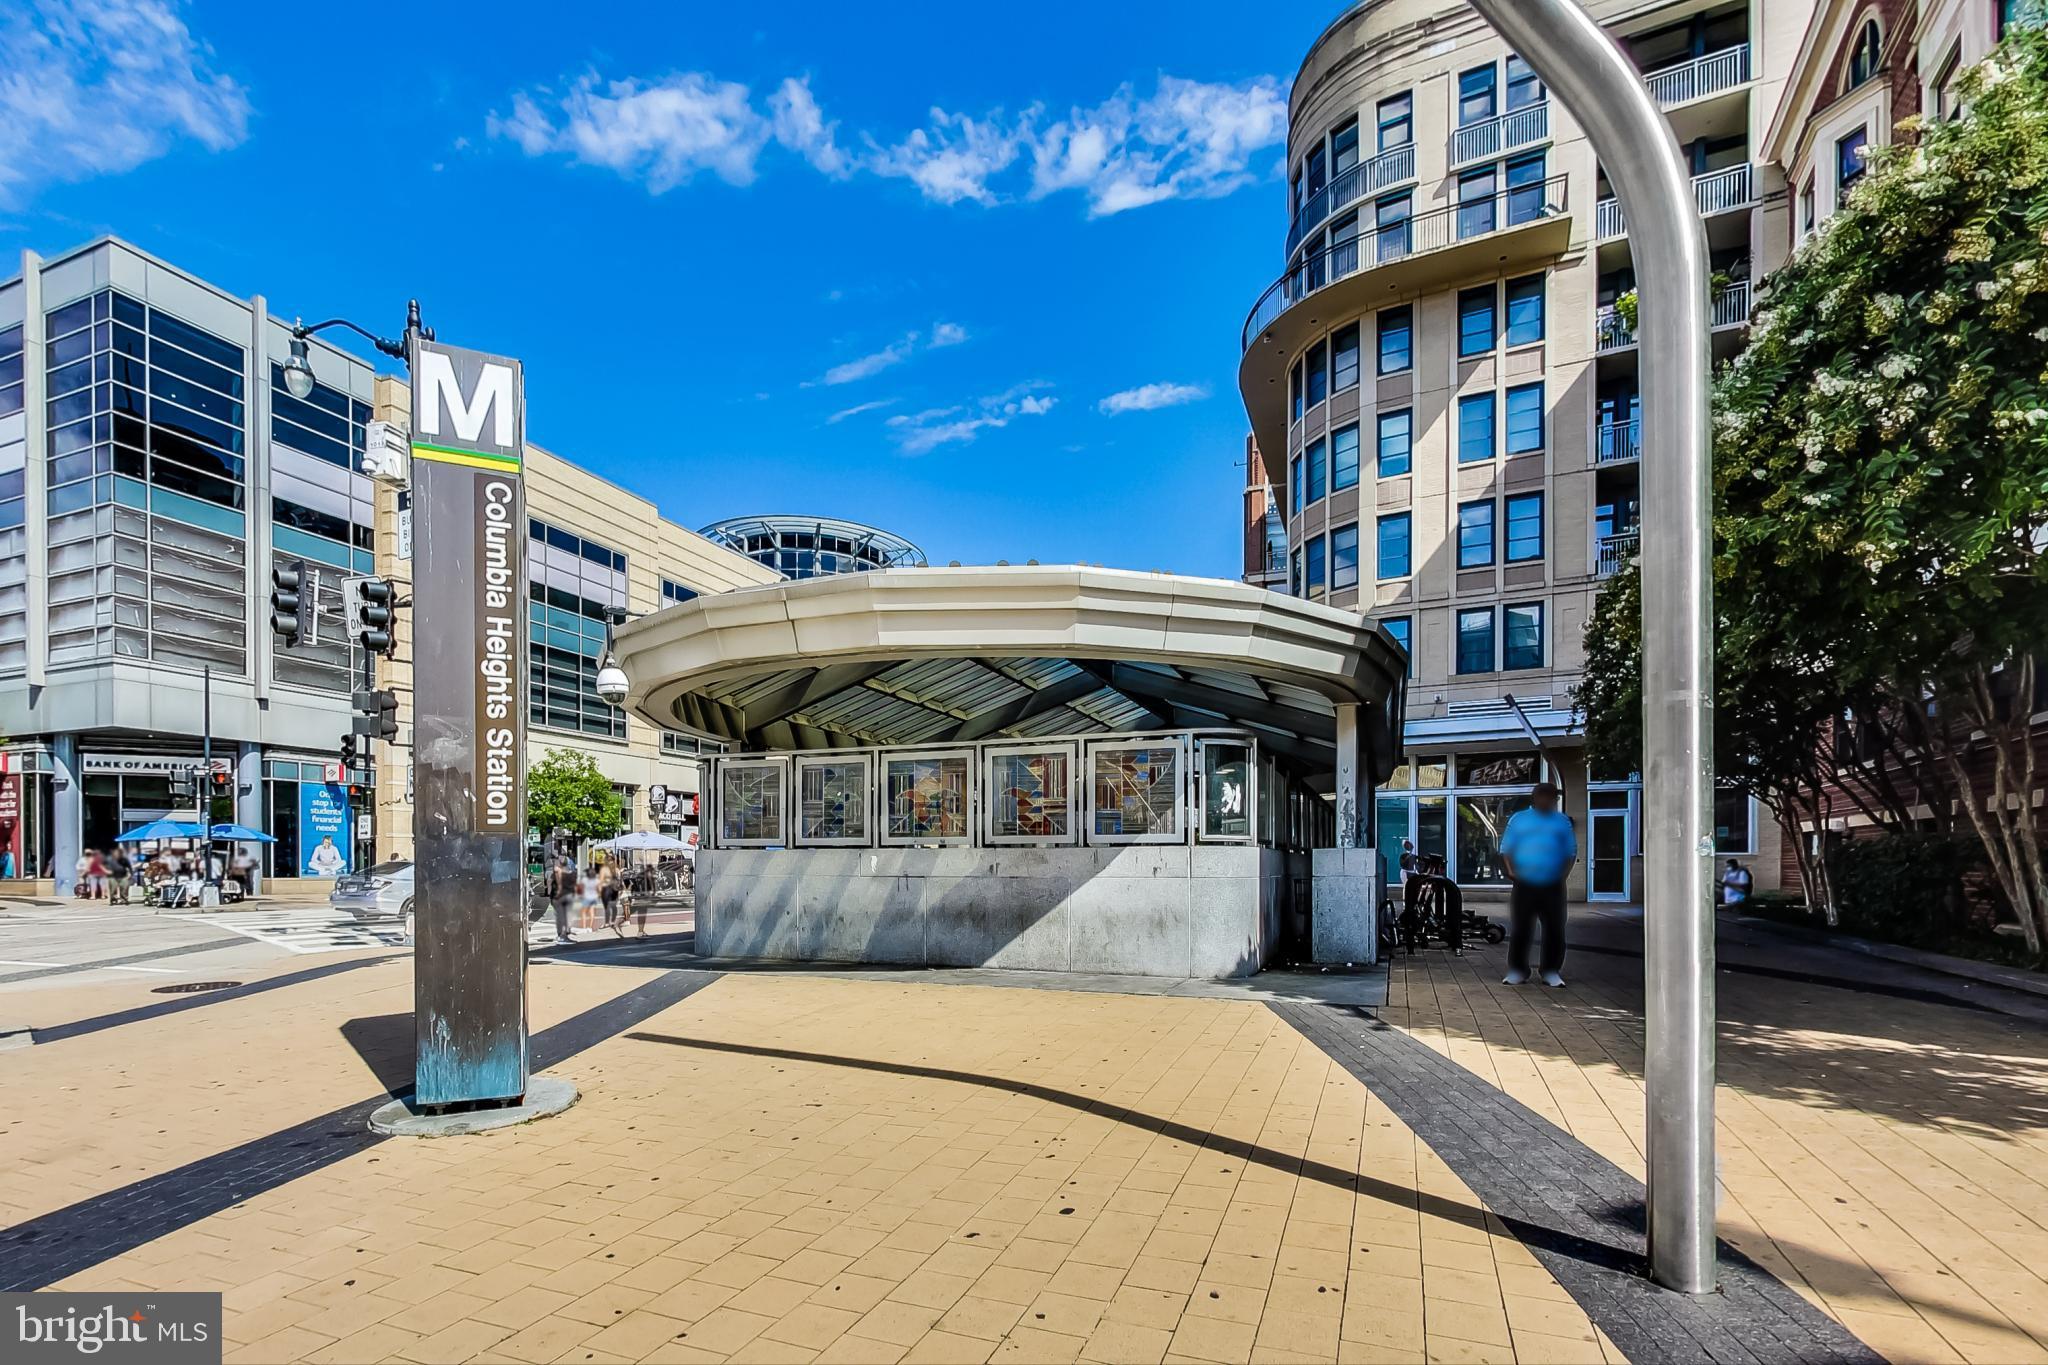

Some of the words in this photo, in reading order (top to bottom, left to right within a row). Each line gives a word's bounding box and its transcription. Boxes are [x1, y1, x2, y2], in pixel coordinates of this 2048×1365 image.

[420, 350, 513, 447] M
[485, 482, 512, 608] Columbia
[481, 616, 512, 719] Heights
[86, 760, 121, 769] BANK
[143, 762, 198, 771] AMERICA
[486, 728, 513, 825] Station
[312, 799, 329, 807] stop
[312, 815, 342, 823] financial
[672, 813, 686, 821] BELL
[316, 824, 338, 832] needs
